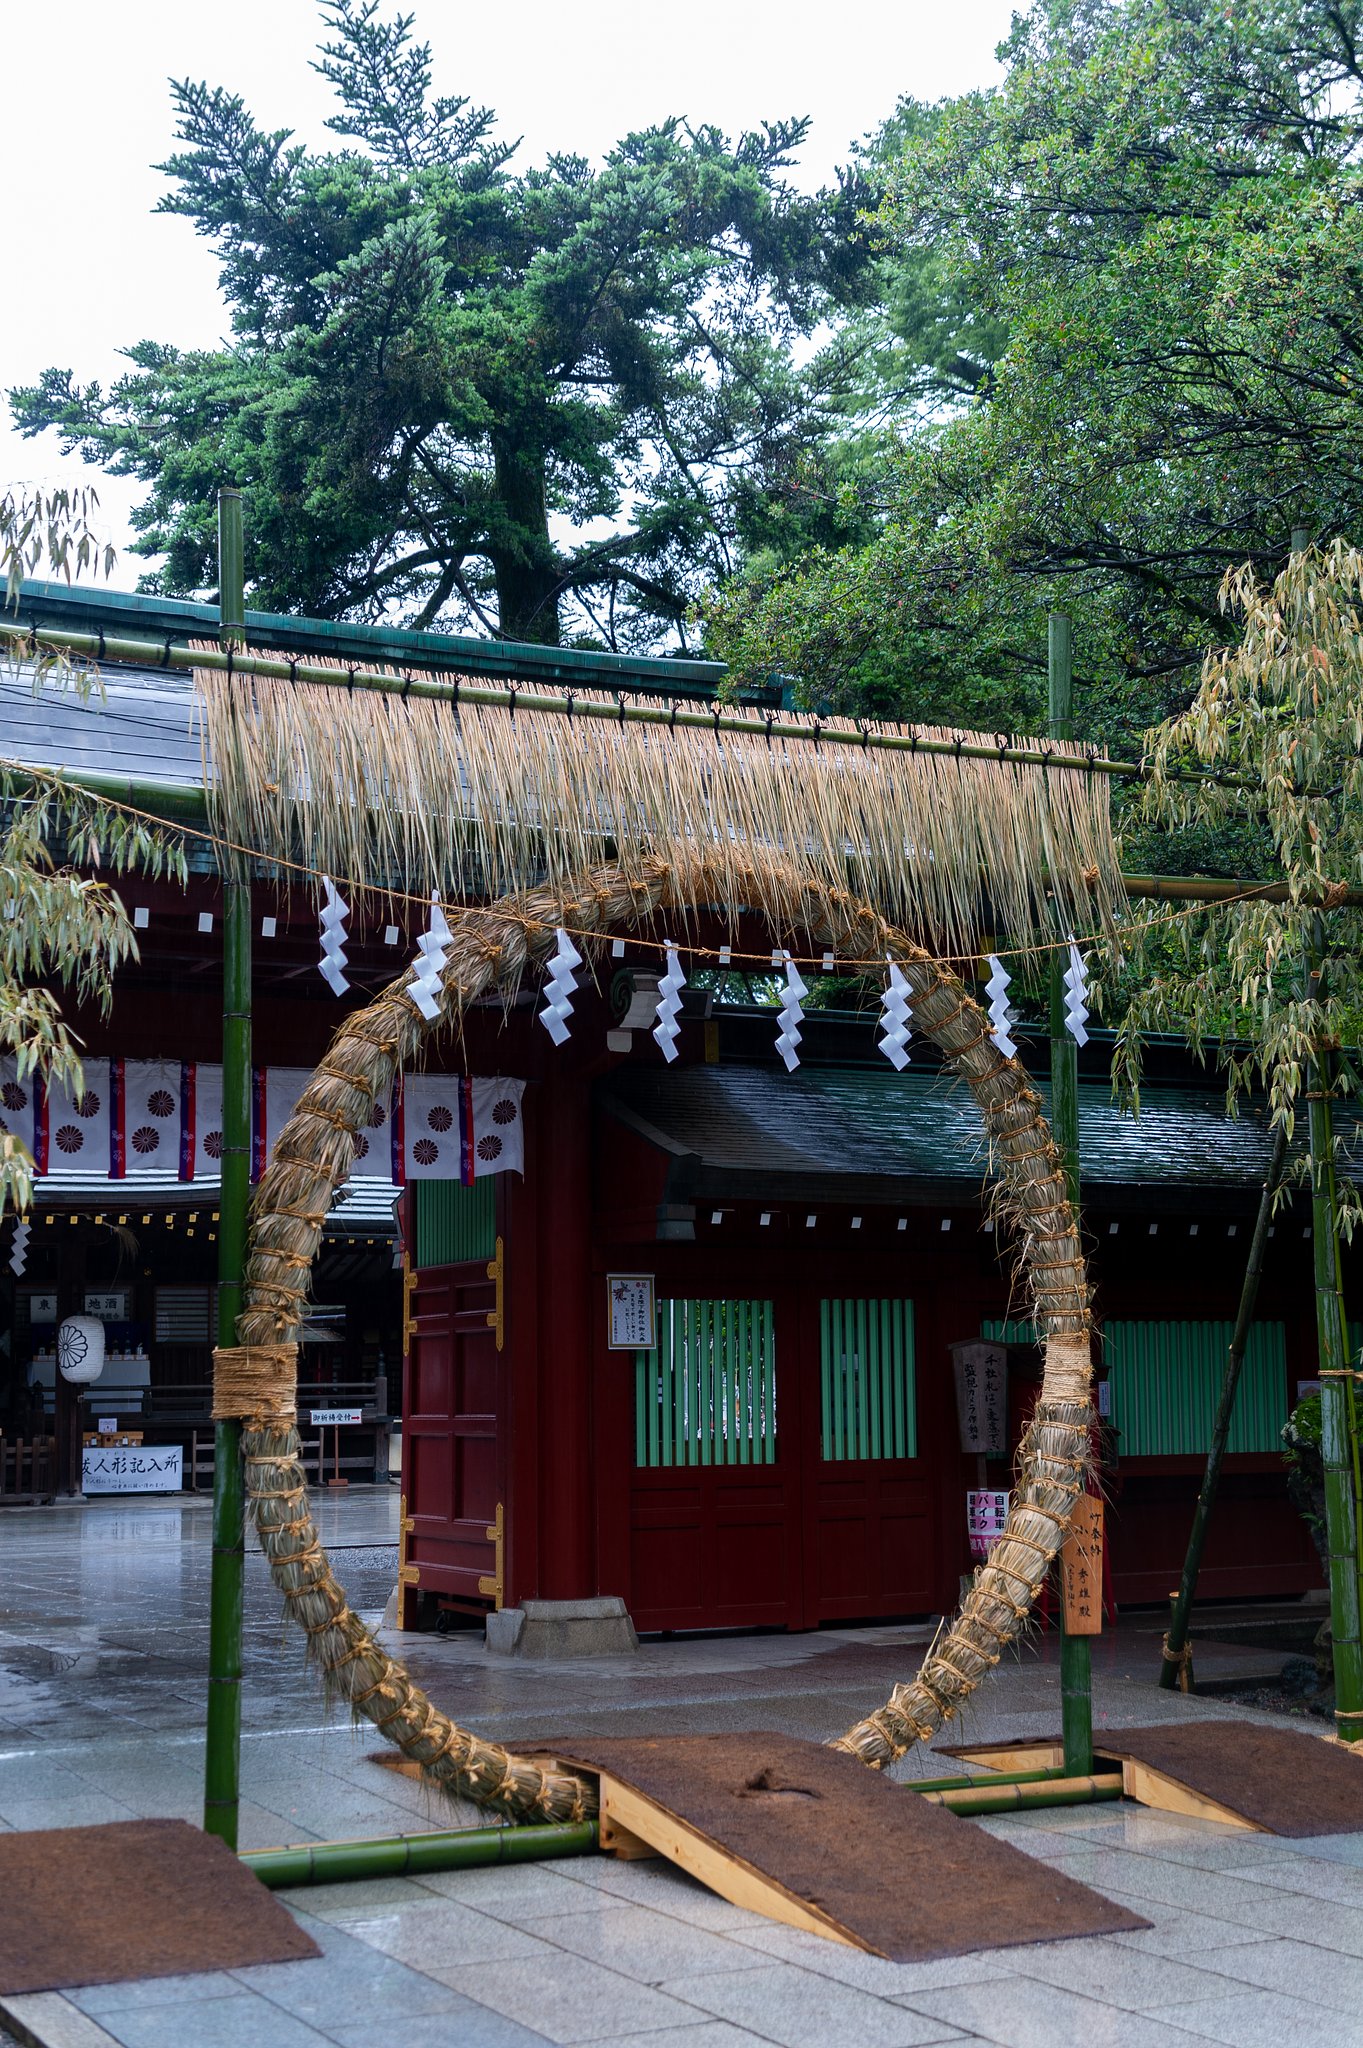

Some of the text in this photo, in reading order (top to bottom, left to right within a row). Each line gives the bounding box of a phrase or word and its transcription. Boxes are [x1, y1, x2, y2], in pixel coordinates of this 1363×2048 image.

[87, 1297, 118, 1310] 地酒
[964, 1363, 978, 1441] 監視カメラ作動中
[979, 1495, 988, 1529] バイク
[995, 1495, 1005, 1529] 自転車
[1089, 1512, 1102, 1557] 竹奉納
